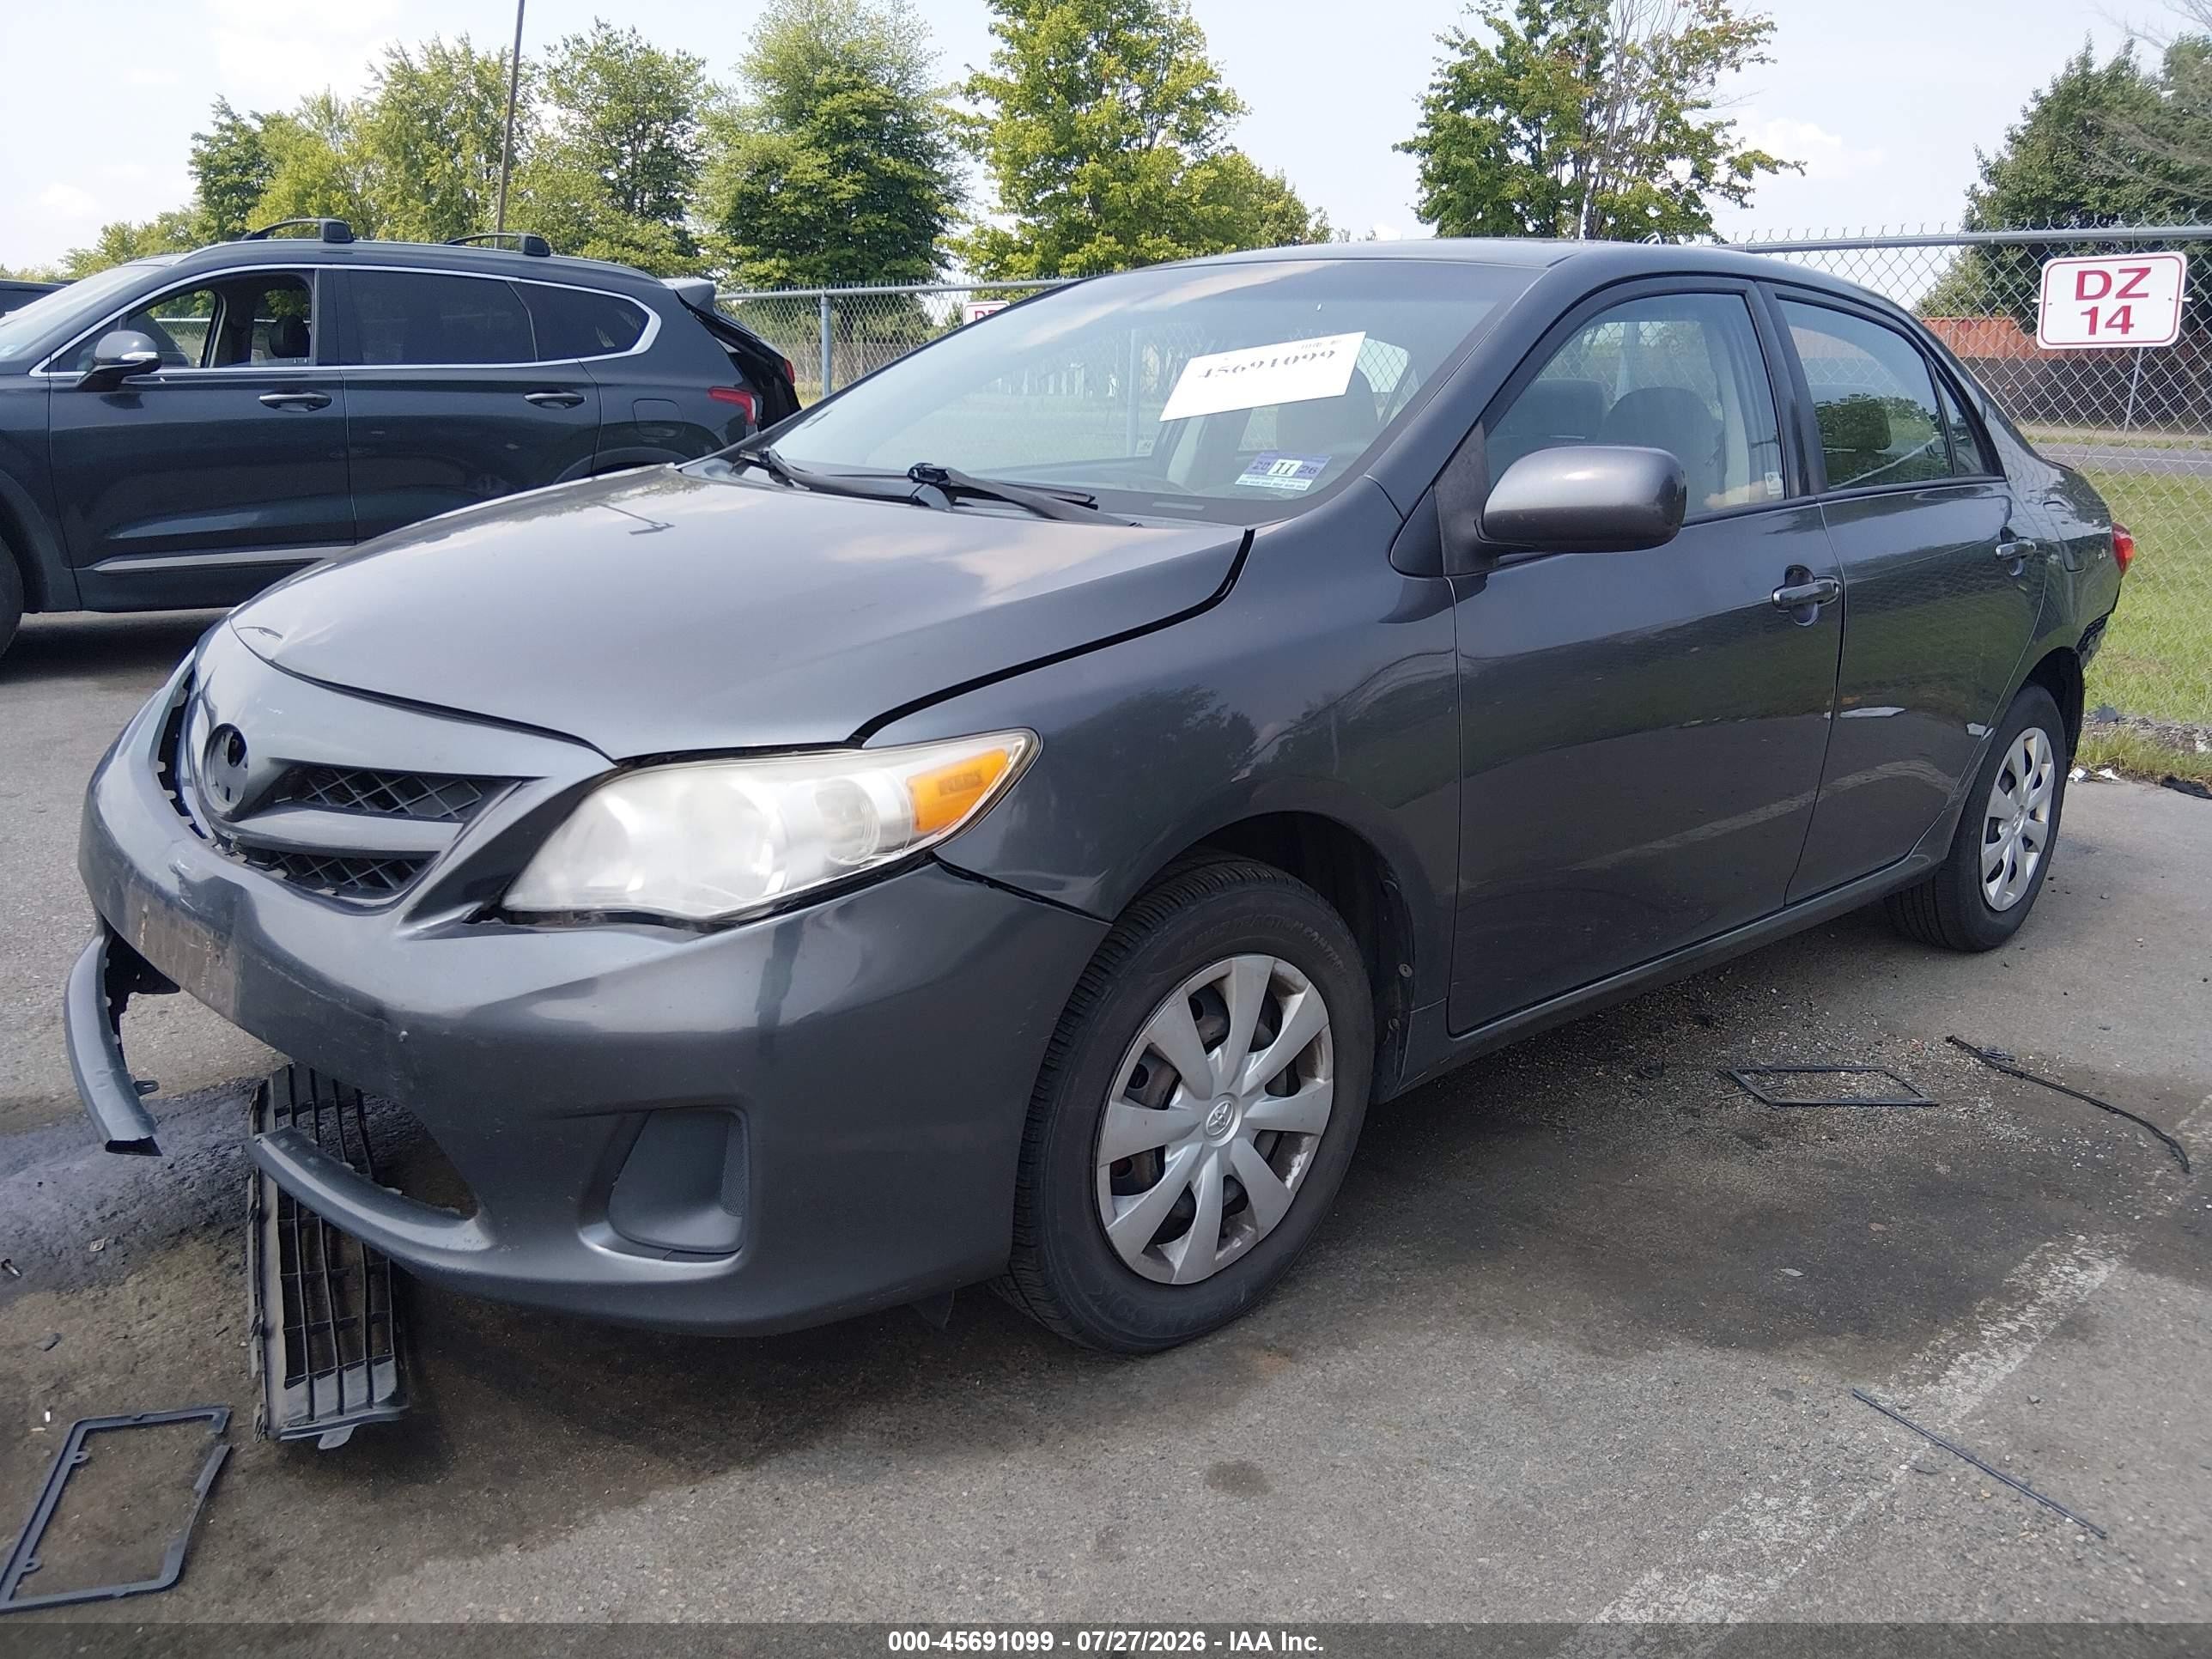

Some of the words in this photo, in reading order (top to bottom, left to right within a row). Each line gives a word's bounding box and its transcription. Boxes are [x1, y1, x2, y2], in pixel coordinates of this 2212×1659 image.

[2075, 267, 2152, 301] DZ
[975, 309, 996, 320] D
[2080, 305, 2135, 336] 14
[1273, 461, 1296, 476] 11
